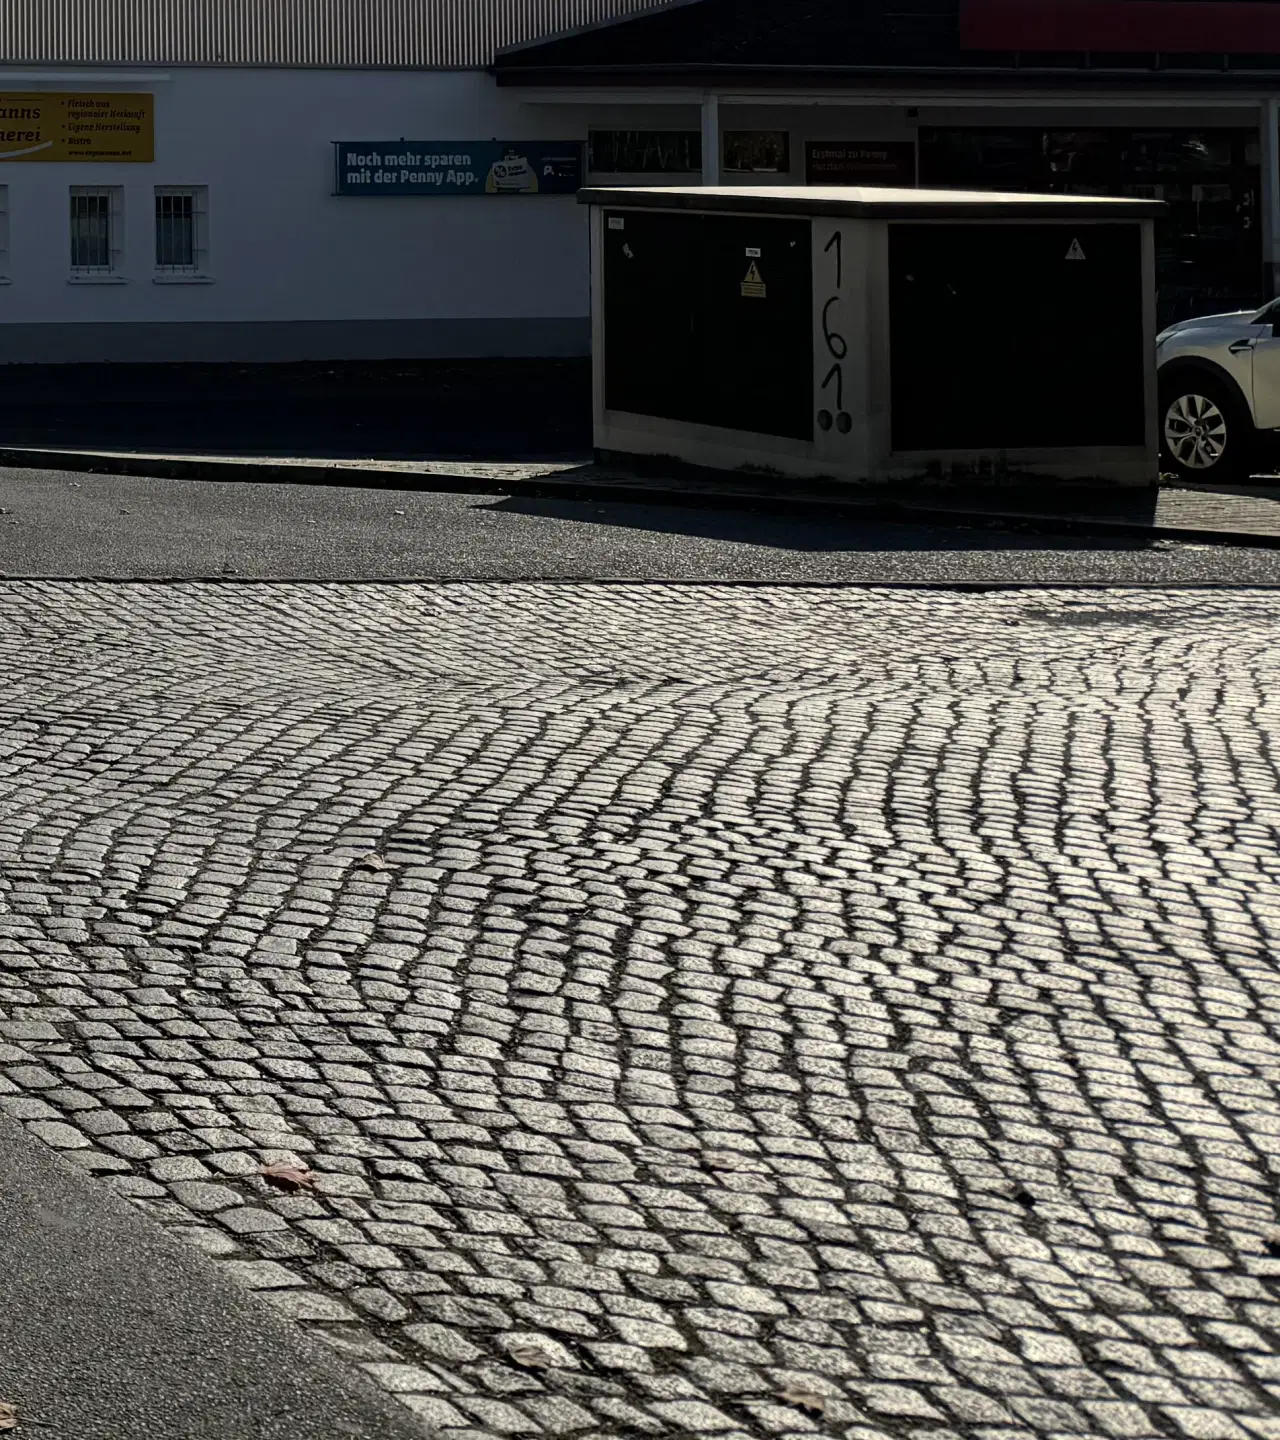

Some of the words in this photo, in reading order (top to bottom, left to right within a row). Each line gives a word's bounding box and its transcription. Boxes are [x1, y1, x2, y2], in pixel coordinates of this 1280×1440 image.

[67, 99, 95, 108] Fleisch
[67, 109, 108, 120] regionaler
[110, 109, 146, 120] Herkunft
[67, 123, 95, 133] Eigene
[95, 122, 141, 134] Herstellung
[346, 152, 383, 167] Noch
[384, 152, 423, 167] mehr
[424, 154, 472, 169] sparen
[346, 168, 372, 184] mit
[373, 169, 399, 184] der
[400, 170, 444, 186] Penny
[446, 170, 479, 186] App.
